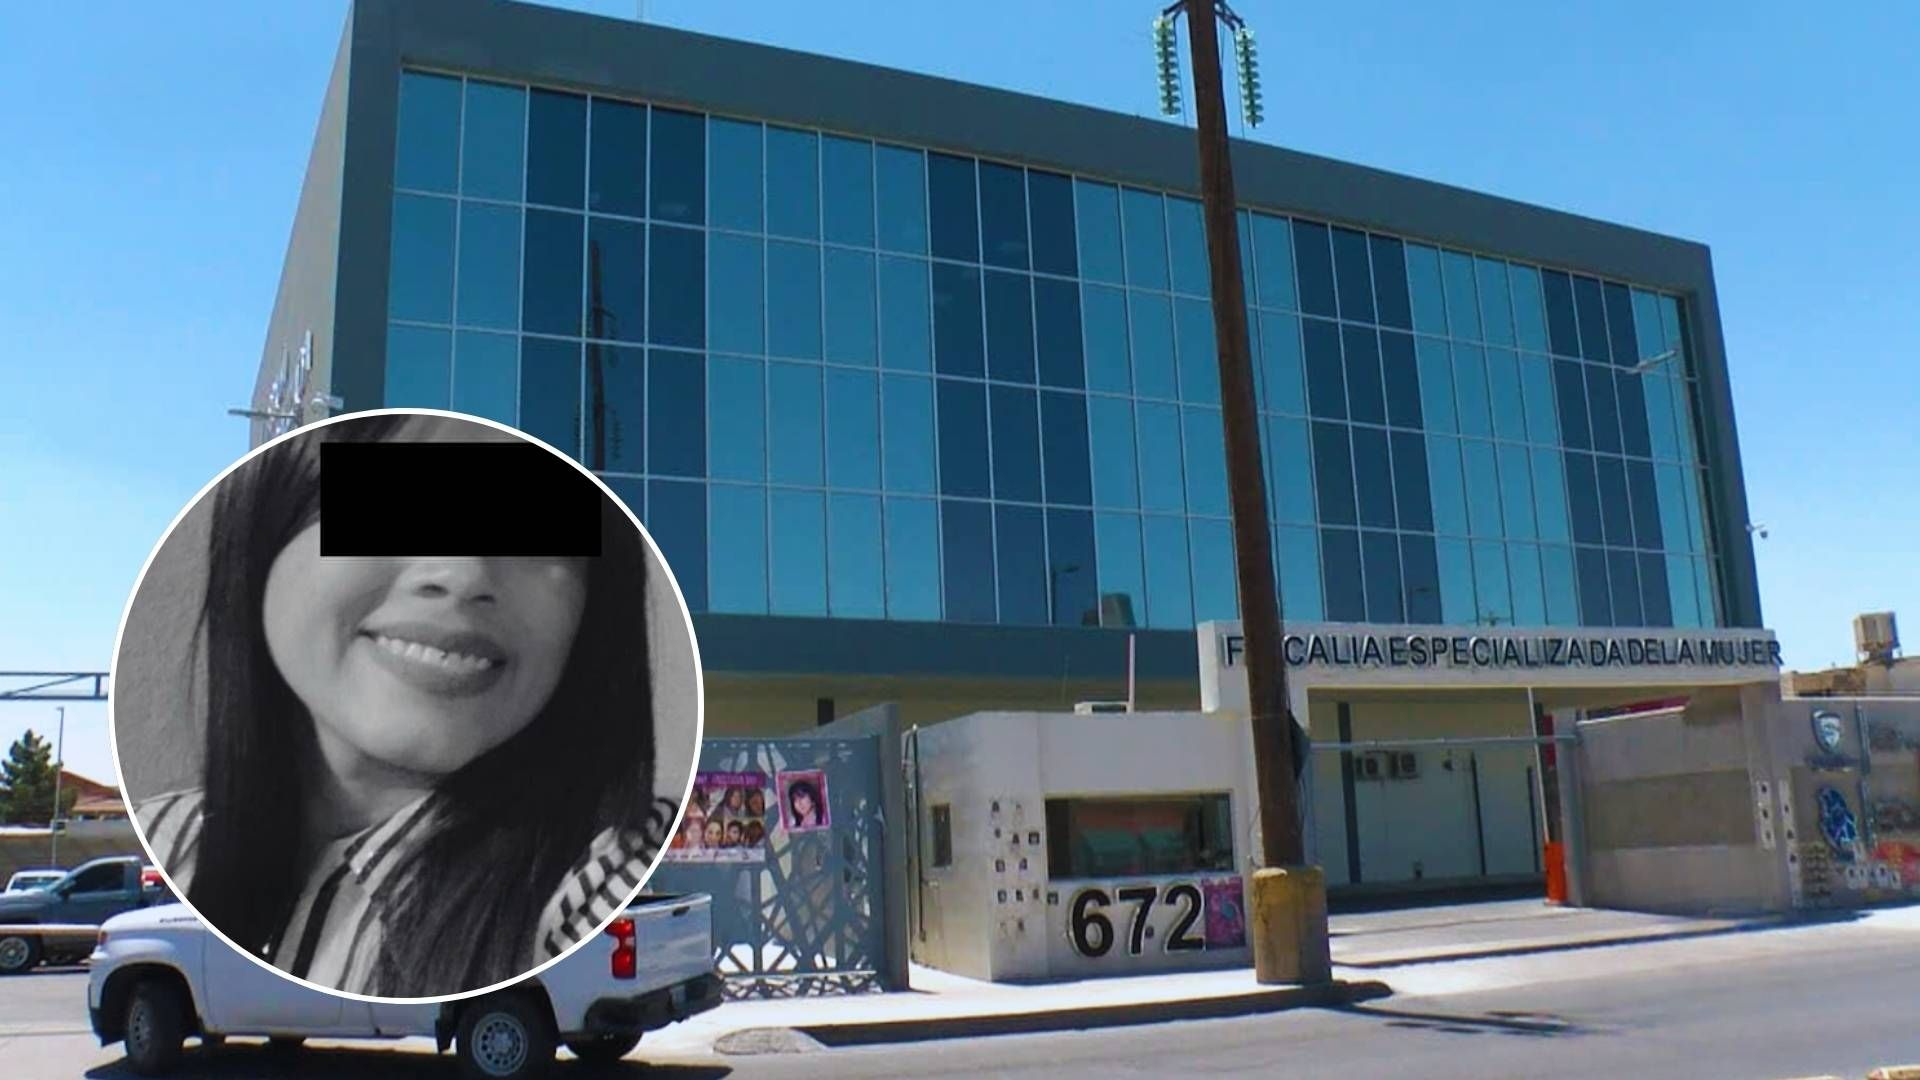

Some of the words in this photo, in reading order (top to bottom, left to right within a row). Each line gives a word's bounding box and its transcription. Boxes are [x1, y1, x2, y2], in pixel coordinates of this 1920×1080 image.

[1225, 635, 1384, 666] FCALIA
[1387, 635, 1624, 667] ESPECIALIZADA
[1627, 637, 1660, 666] DE
[1662, 637, 1695, 666] LA
[1700, 638, 1784, 667] MUJER
[1069, 882, 1206, 958] 672
